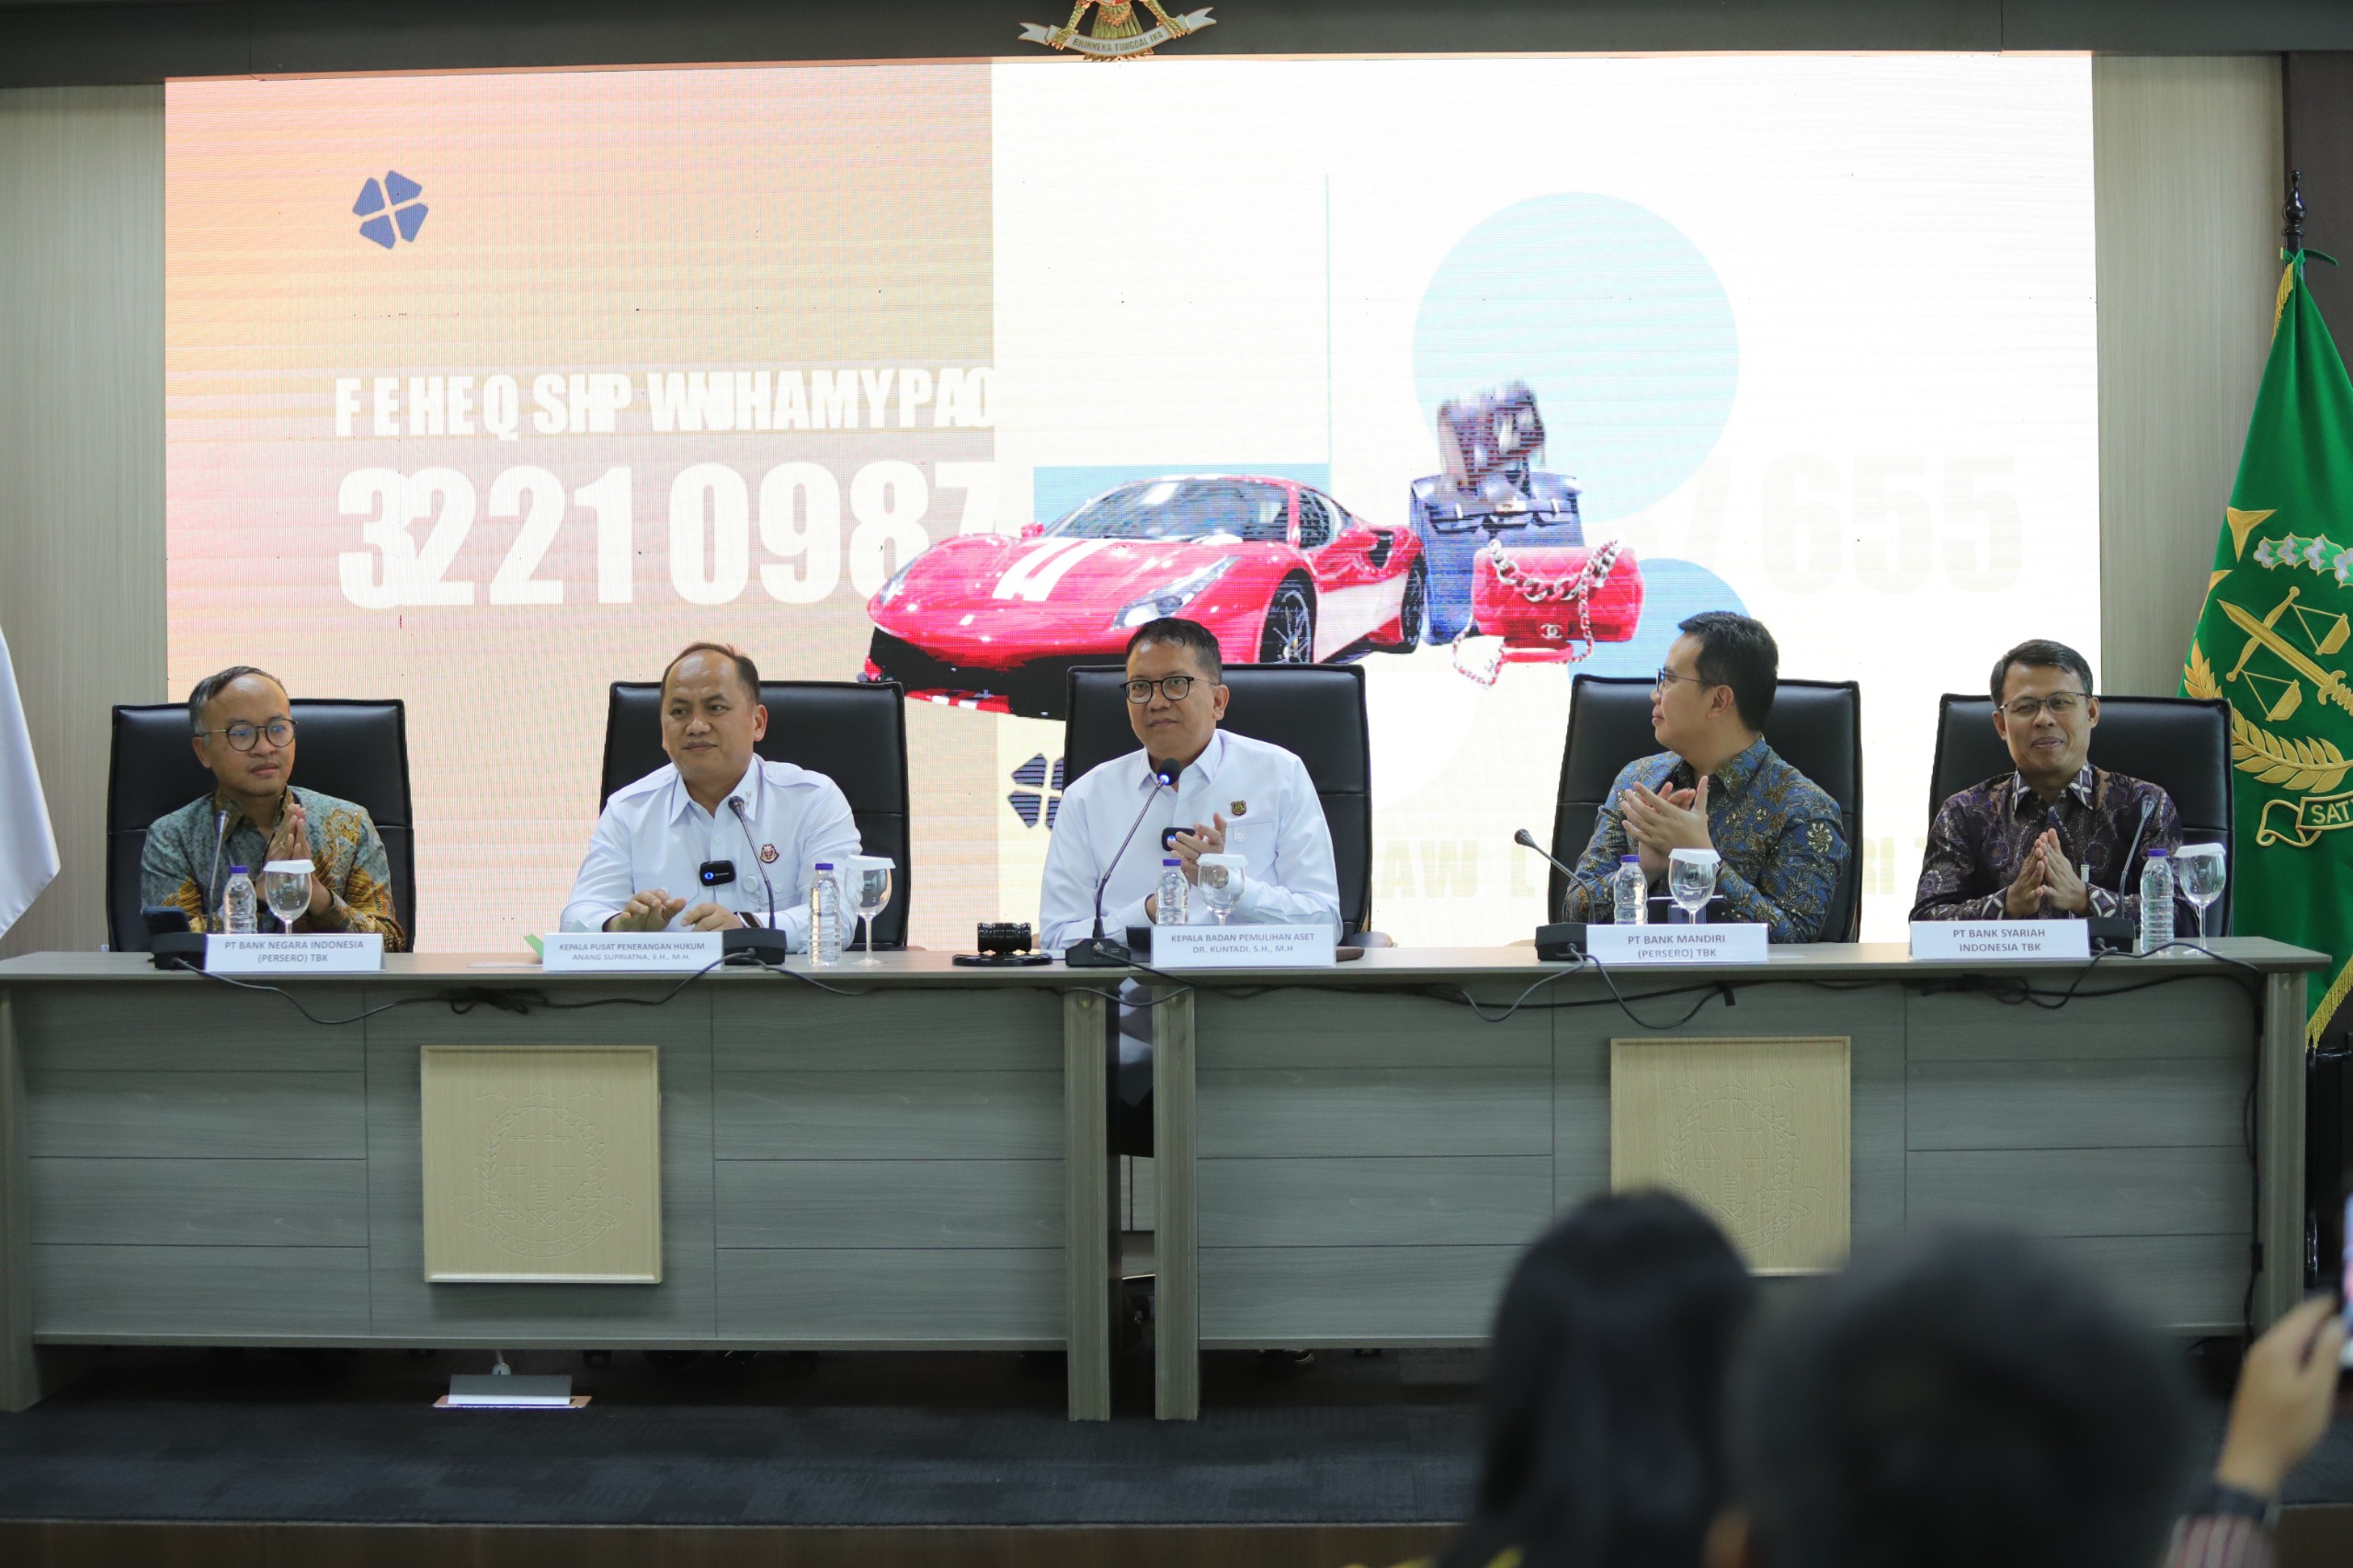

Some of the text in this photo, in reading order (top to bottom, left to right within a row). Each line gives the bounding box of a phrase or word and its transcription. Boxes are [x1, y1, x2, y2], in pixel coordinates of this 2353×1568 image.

[1150, 30, 1164, 44] IKA
[2311, 799, 2353, 824] SAT
[1205, 934, 1236, 942] BADAN
[1239, 933, 1291, 941] PEMULIHAN
[1293, 933, 1315, 941] ASET
[1953, 928, 2045, 938] PT BANK SYARIAH
[224, 940, 364, 949] PT BANK NEGARA INDONESIA
[1628, 935, 1726, 945] PT BANK MANDIRI
[1210, 946, 1251, 954] KUNTADI,
[1959, 942, 2041, 952] INDONESIA TBK
[257, 954, 328, 963] (PERSERO) TBK
[1637, 949, 1717, 959] (PERSERO) TBK
